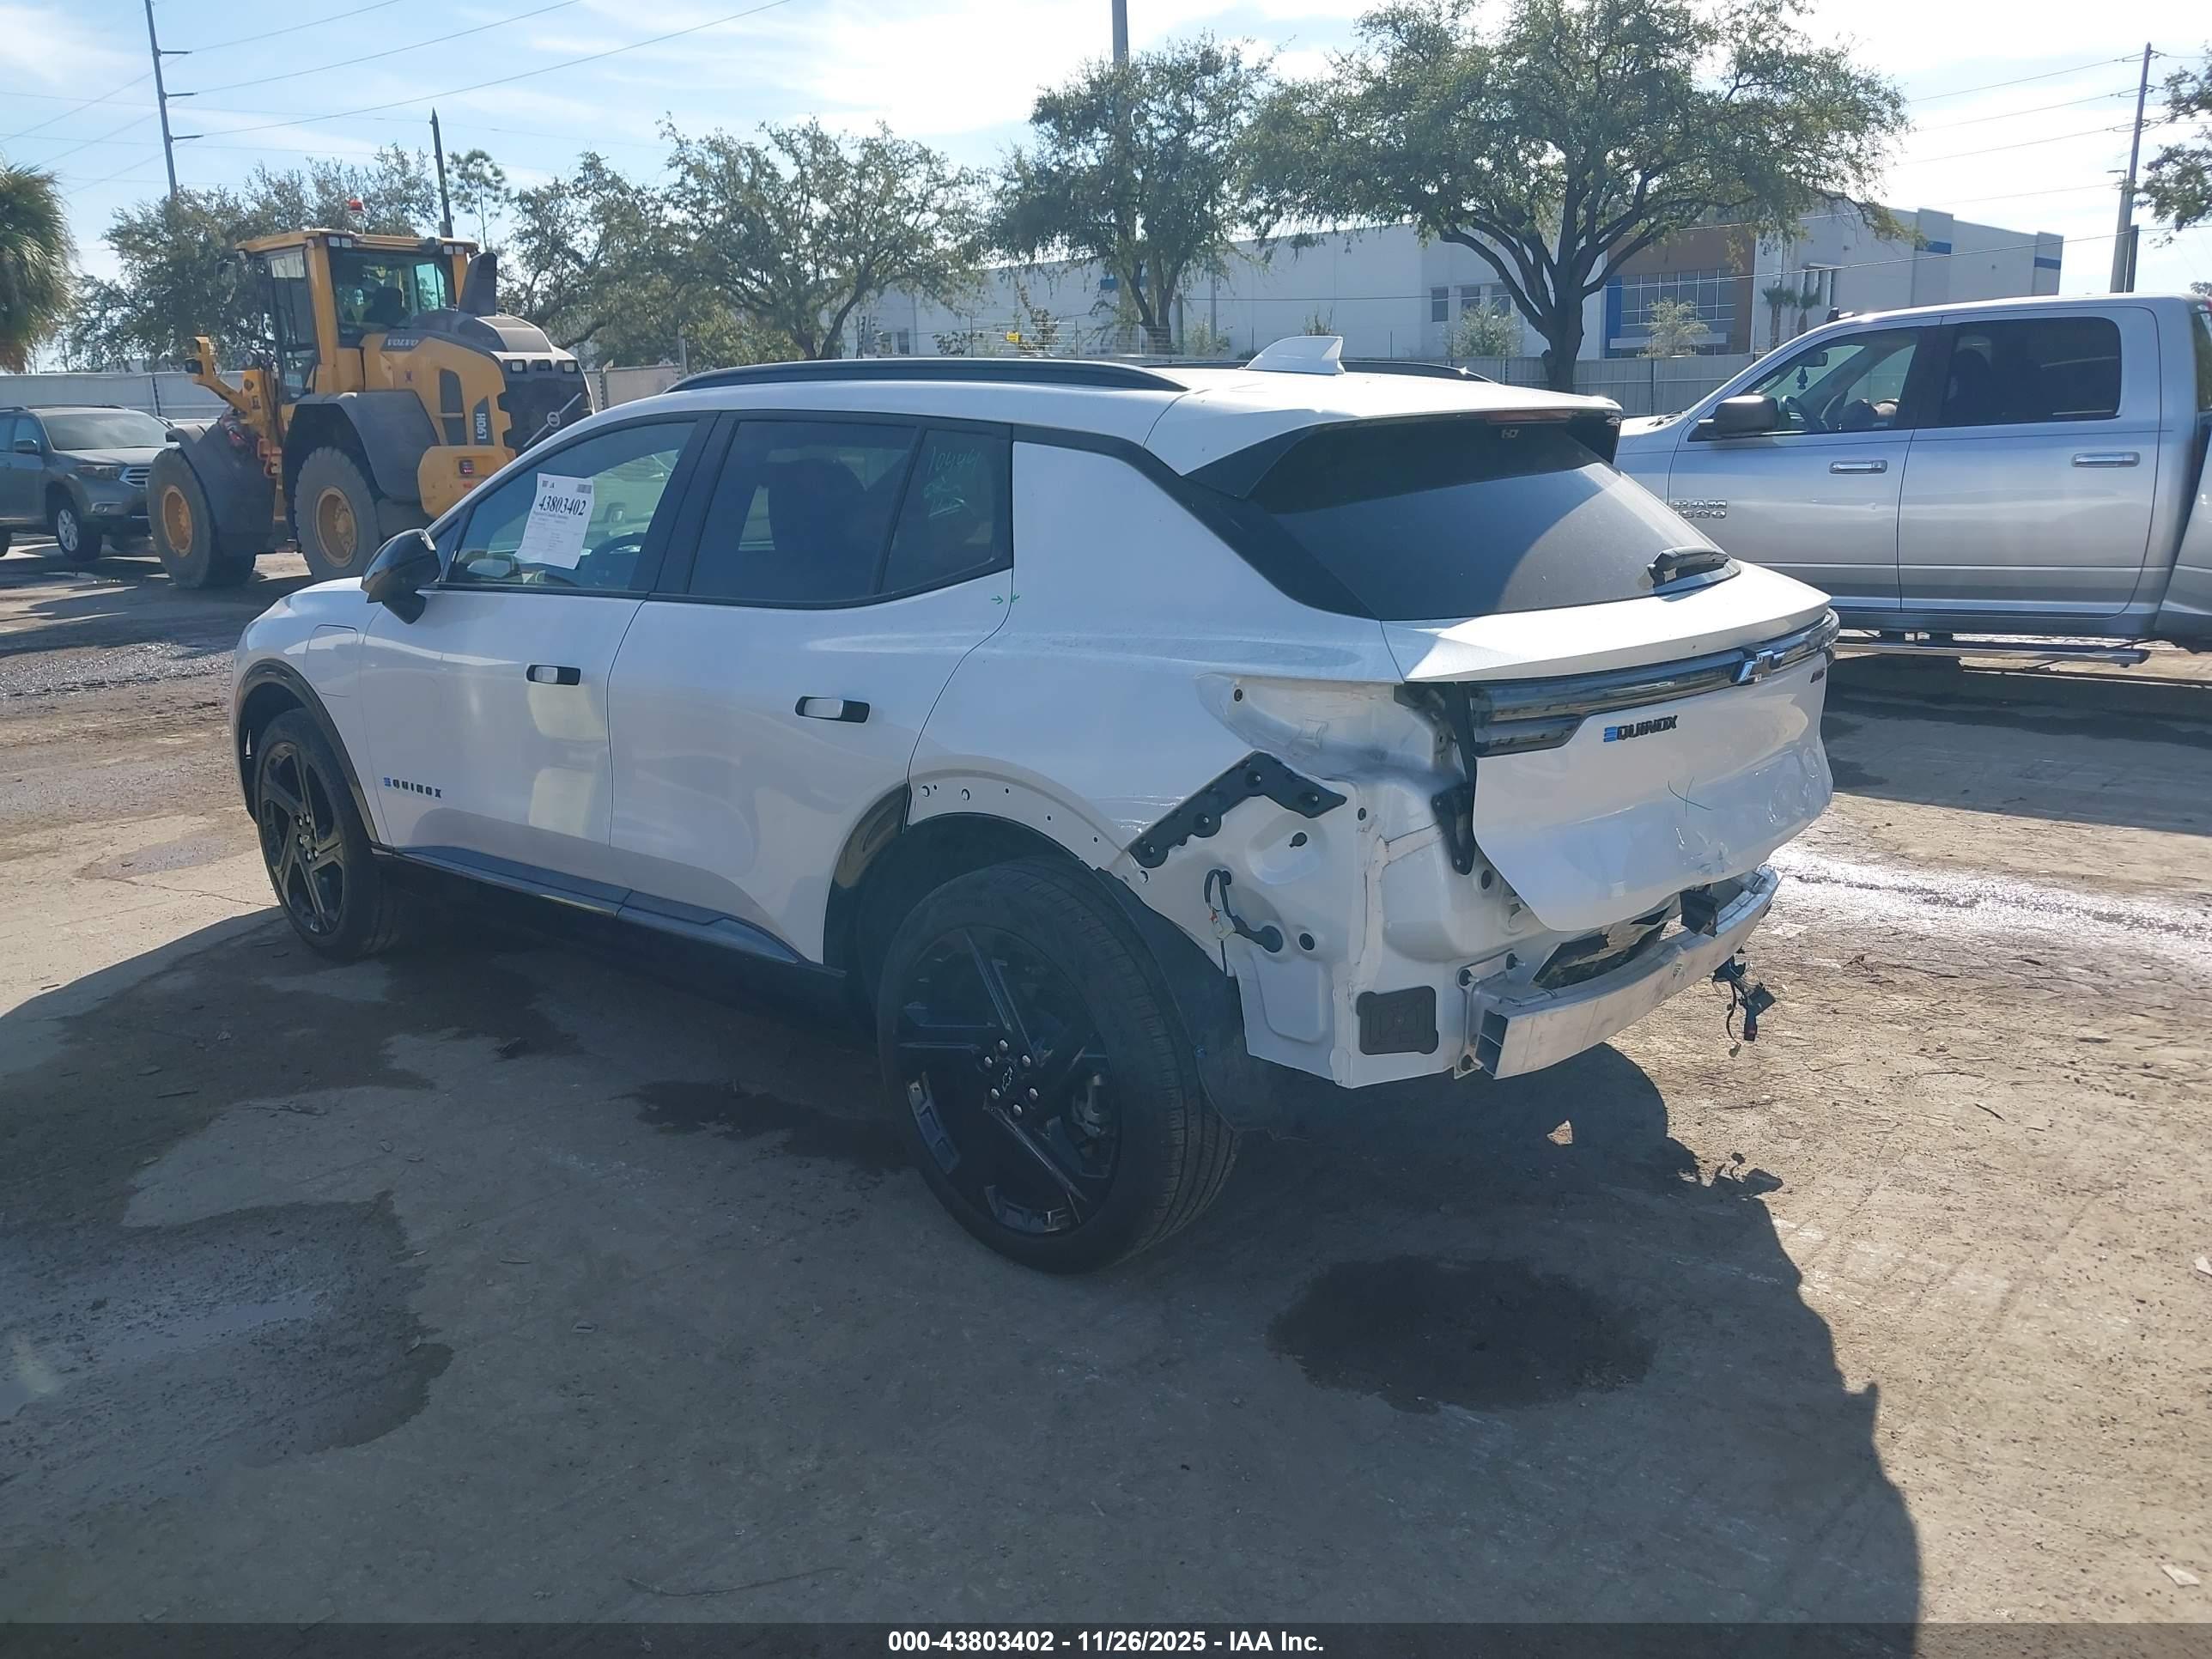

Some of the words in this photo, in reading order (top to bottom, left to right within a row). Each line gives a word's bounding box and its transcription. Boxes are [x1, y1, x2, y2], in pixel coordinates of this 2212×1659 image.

[387, 338, 419, 347] VOLVO
[476, 413, 487, 440] L90H
[538, 495, 586, 516] 43803402
[1673, 499, 1728, 509] RAM
[1603, 715, 1678, 742] EQUINOX
[383, 776, 441, 799] EQUINOX
